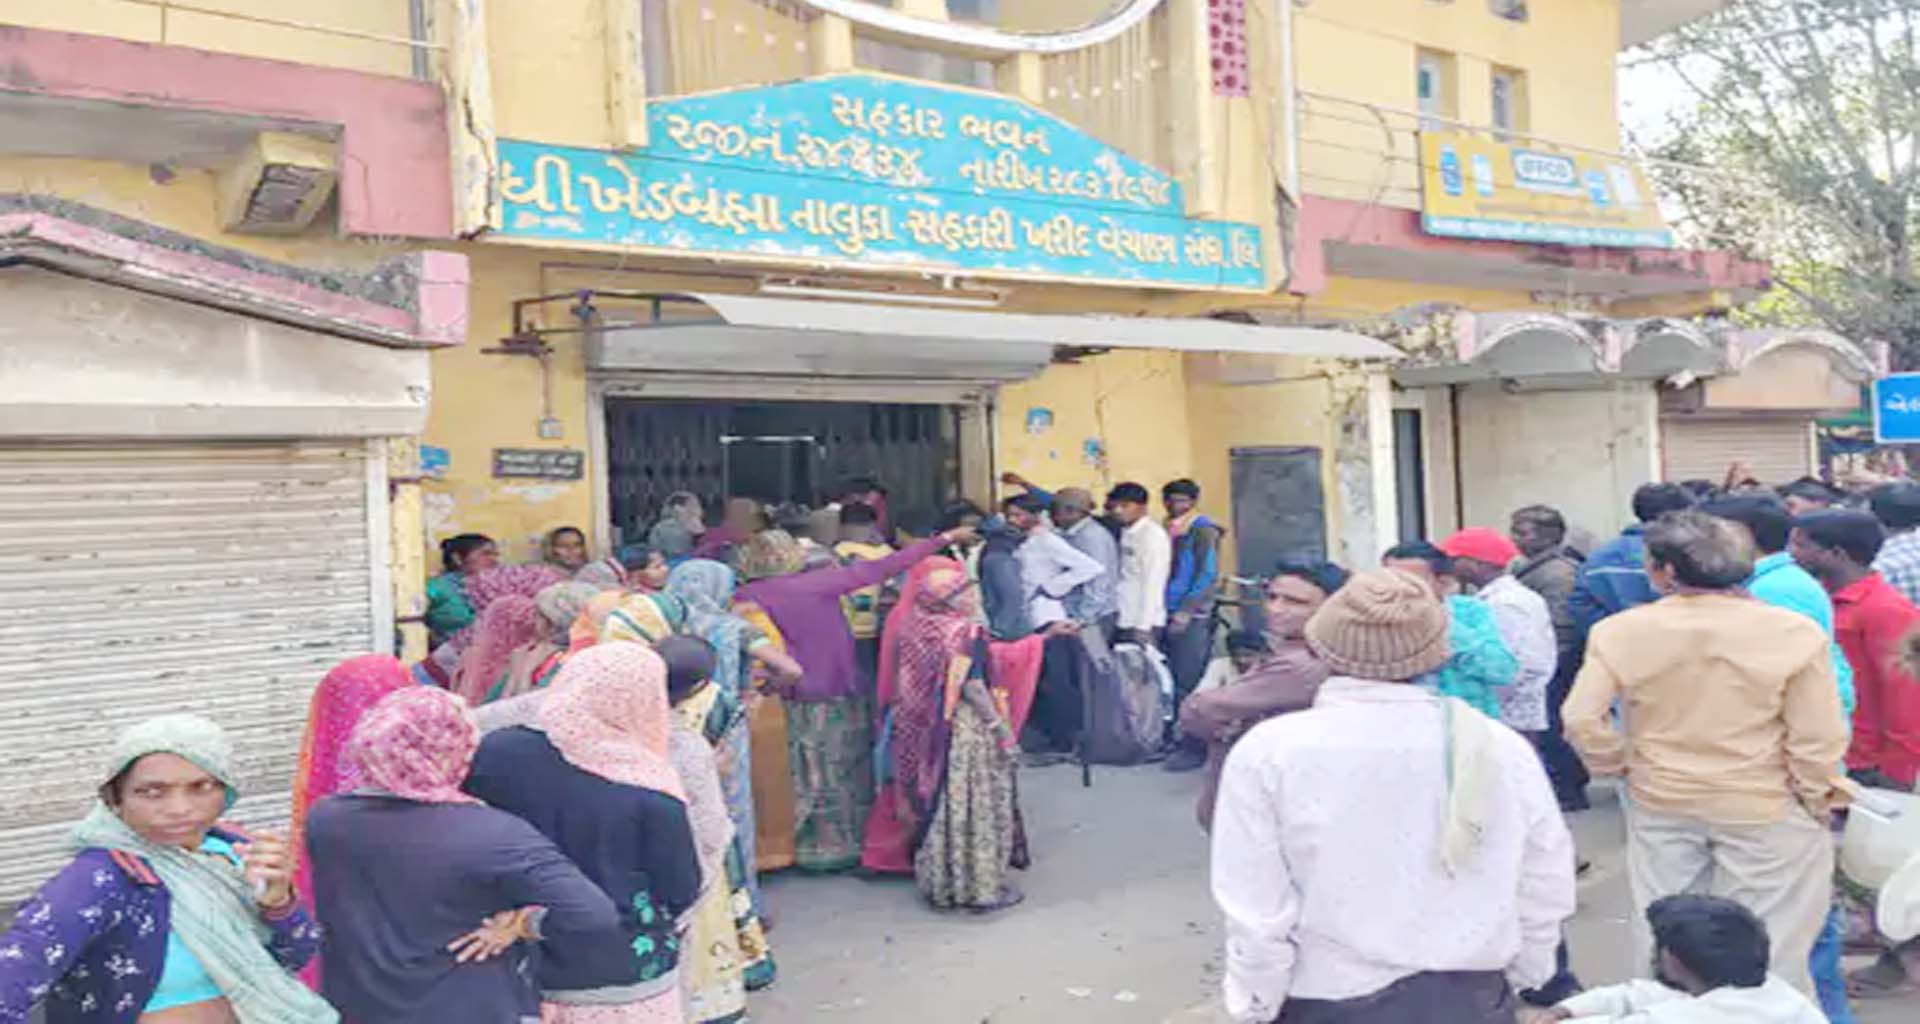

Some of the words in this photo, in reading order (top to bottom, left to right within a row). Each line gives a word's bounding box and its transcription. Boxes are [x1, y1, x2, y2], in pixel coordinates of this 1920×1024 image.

[833, 96, 943, 136] સહકાર
[961, 115, 1049, 151] ભવન
[789, 199, 895, 255] તાલુકા
[907, 208, 1015, 251] સહકારી
[1020, 214, 1092, 257] ખરીદ
[1096, 215, 1179, 265] વેચાણ
